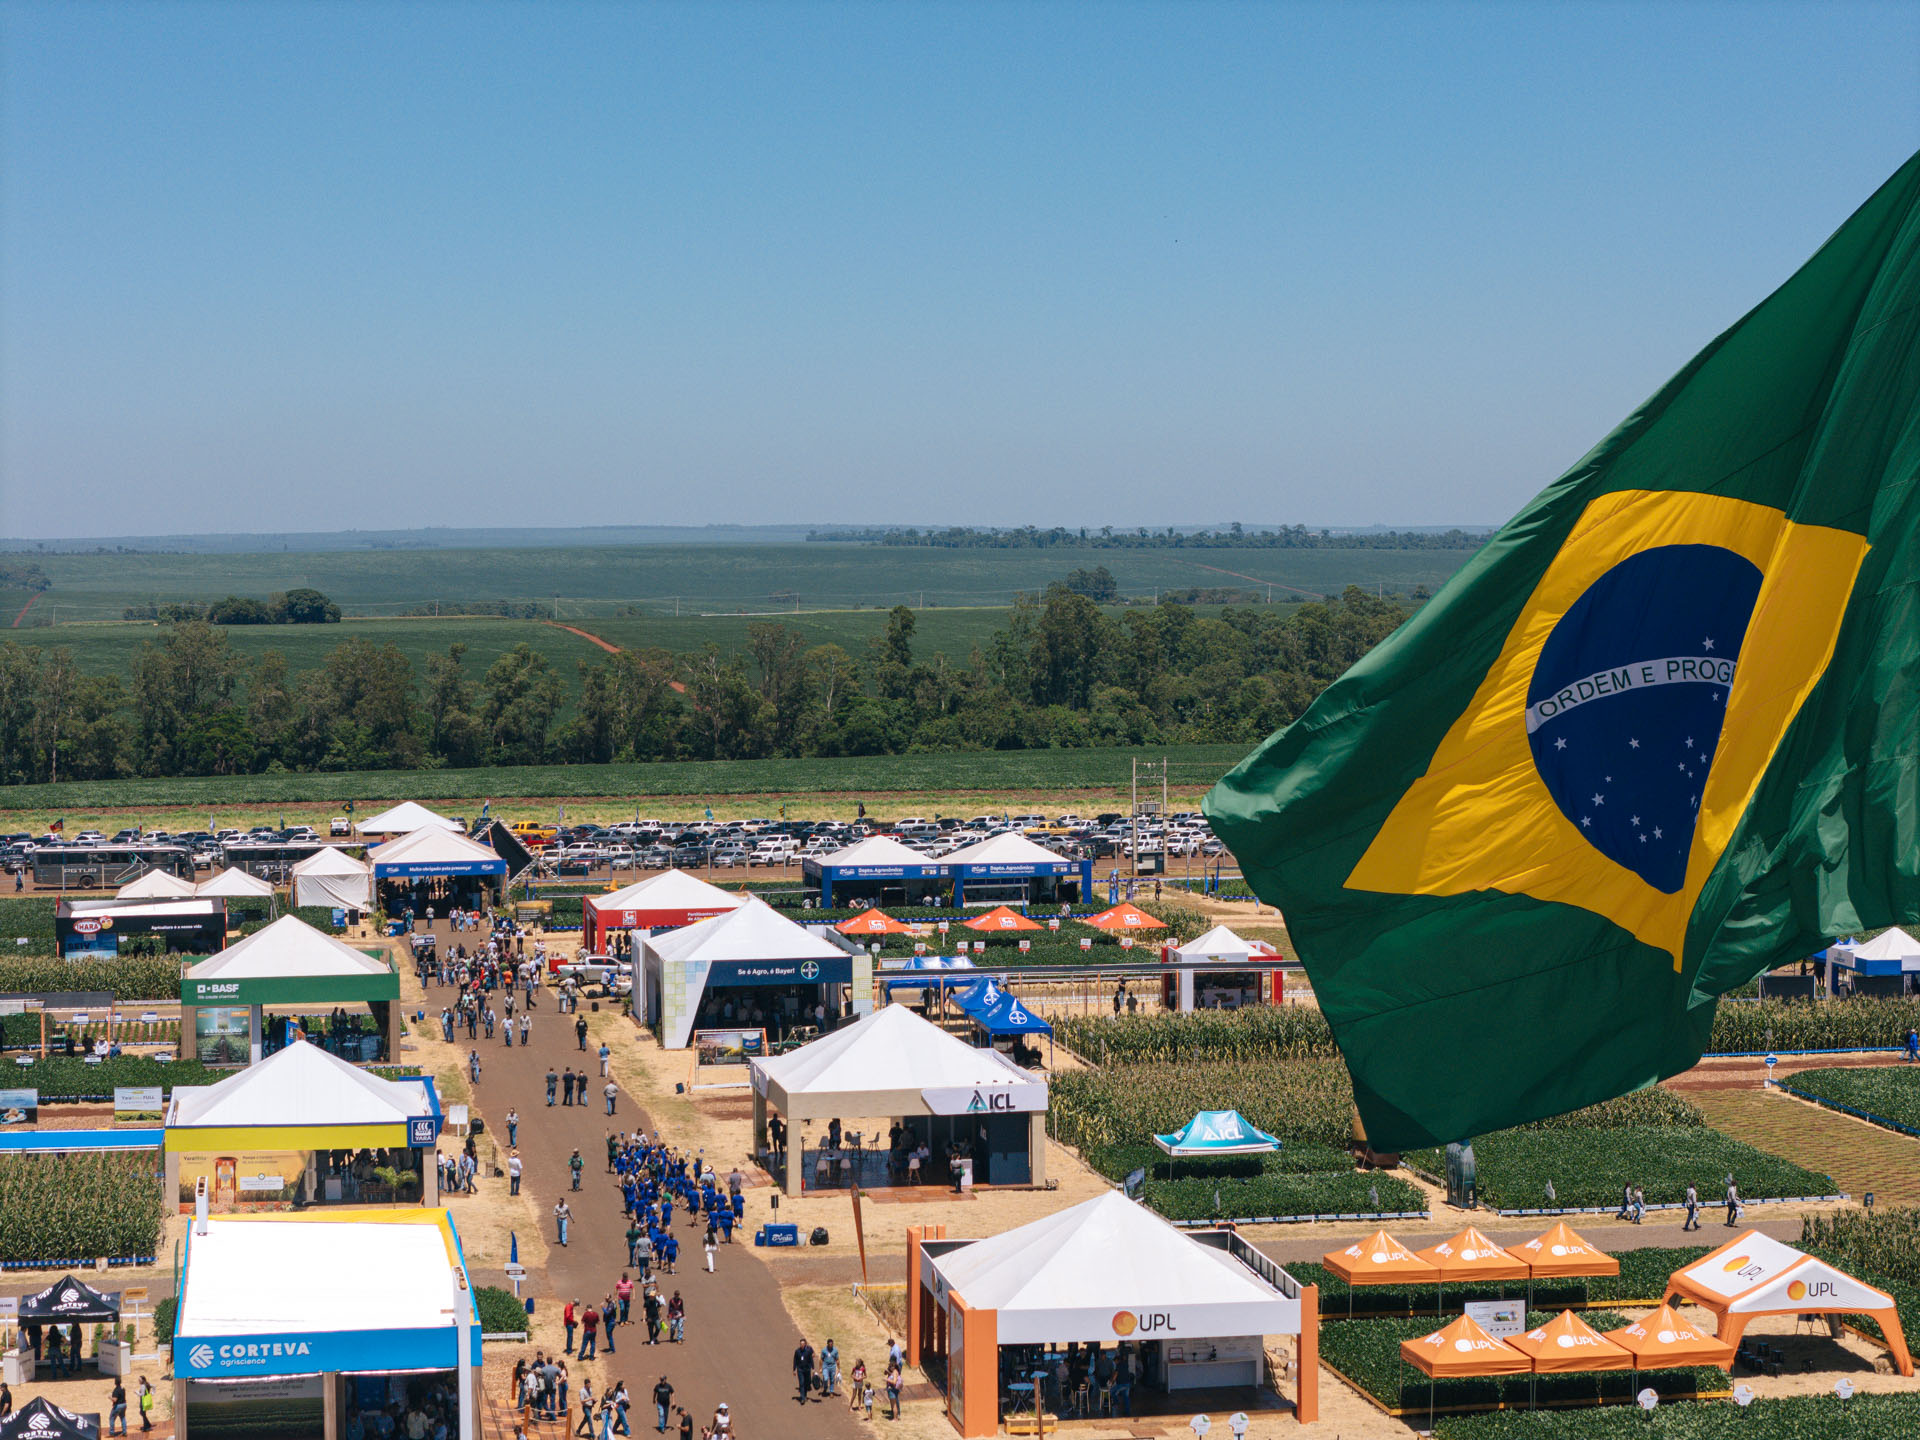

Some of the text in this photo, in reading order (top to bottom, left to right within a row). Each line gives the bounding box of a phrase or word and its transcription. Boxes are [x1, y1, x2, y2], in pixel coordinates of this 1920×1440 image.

[1539, 669, 1632, 717] ORDEM
[1641, 666, 1655, 683] E
[212, 984, 239, 992] BASF
[989, 1093, 1015, 1110] ICL
[1220, 1127, 1244, 1141] ICL
[1737, 1263, 1766, 1281] UPL
[1808, 1282, 1838, 1297] UPL
[1139, 1312, 1177, 1332] UPL
[219, 1342, 310, 1358] CORTEVA
[220, 1358, 266, 1367] agriscience
